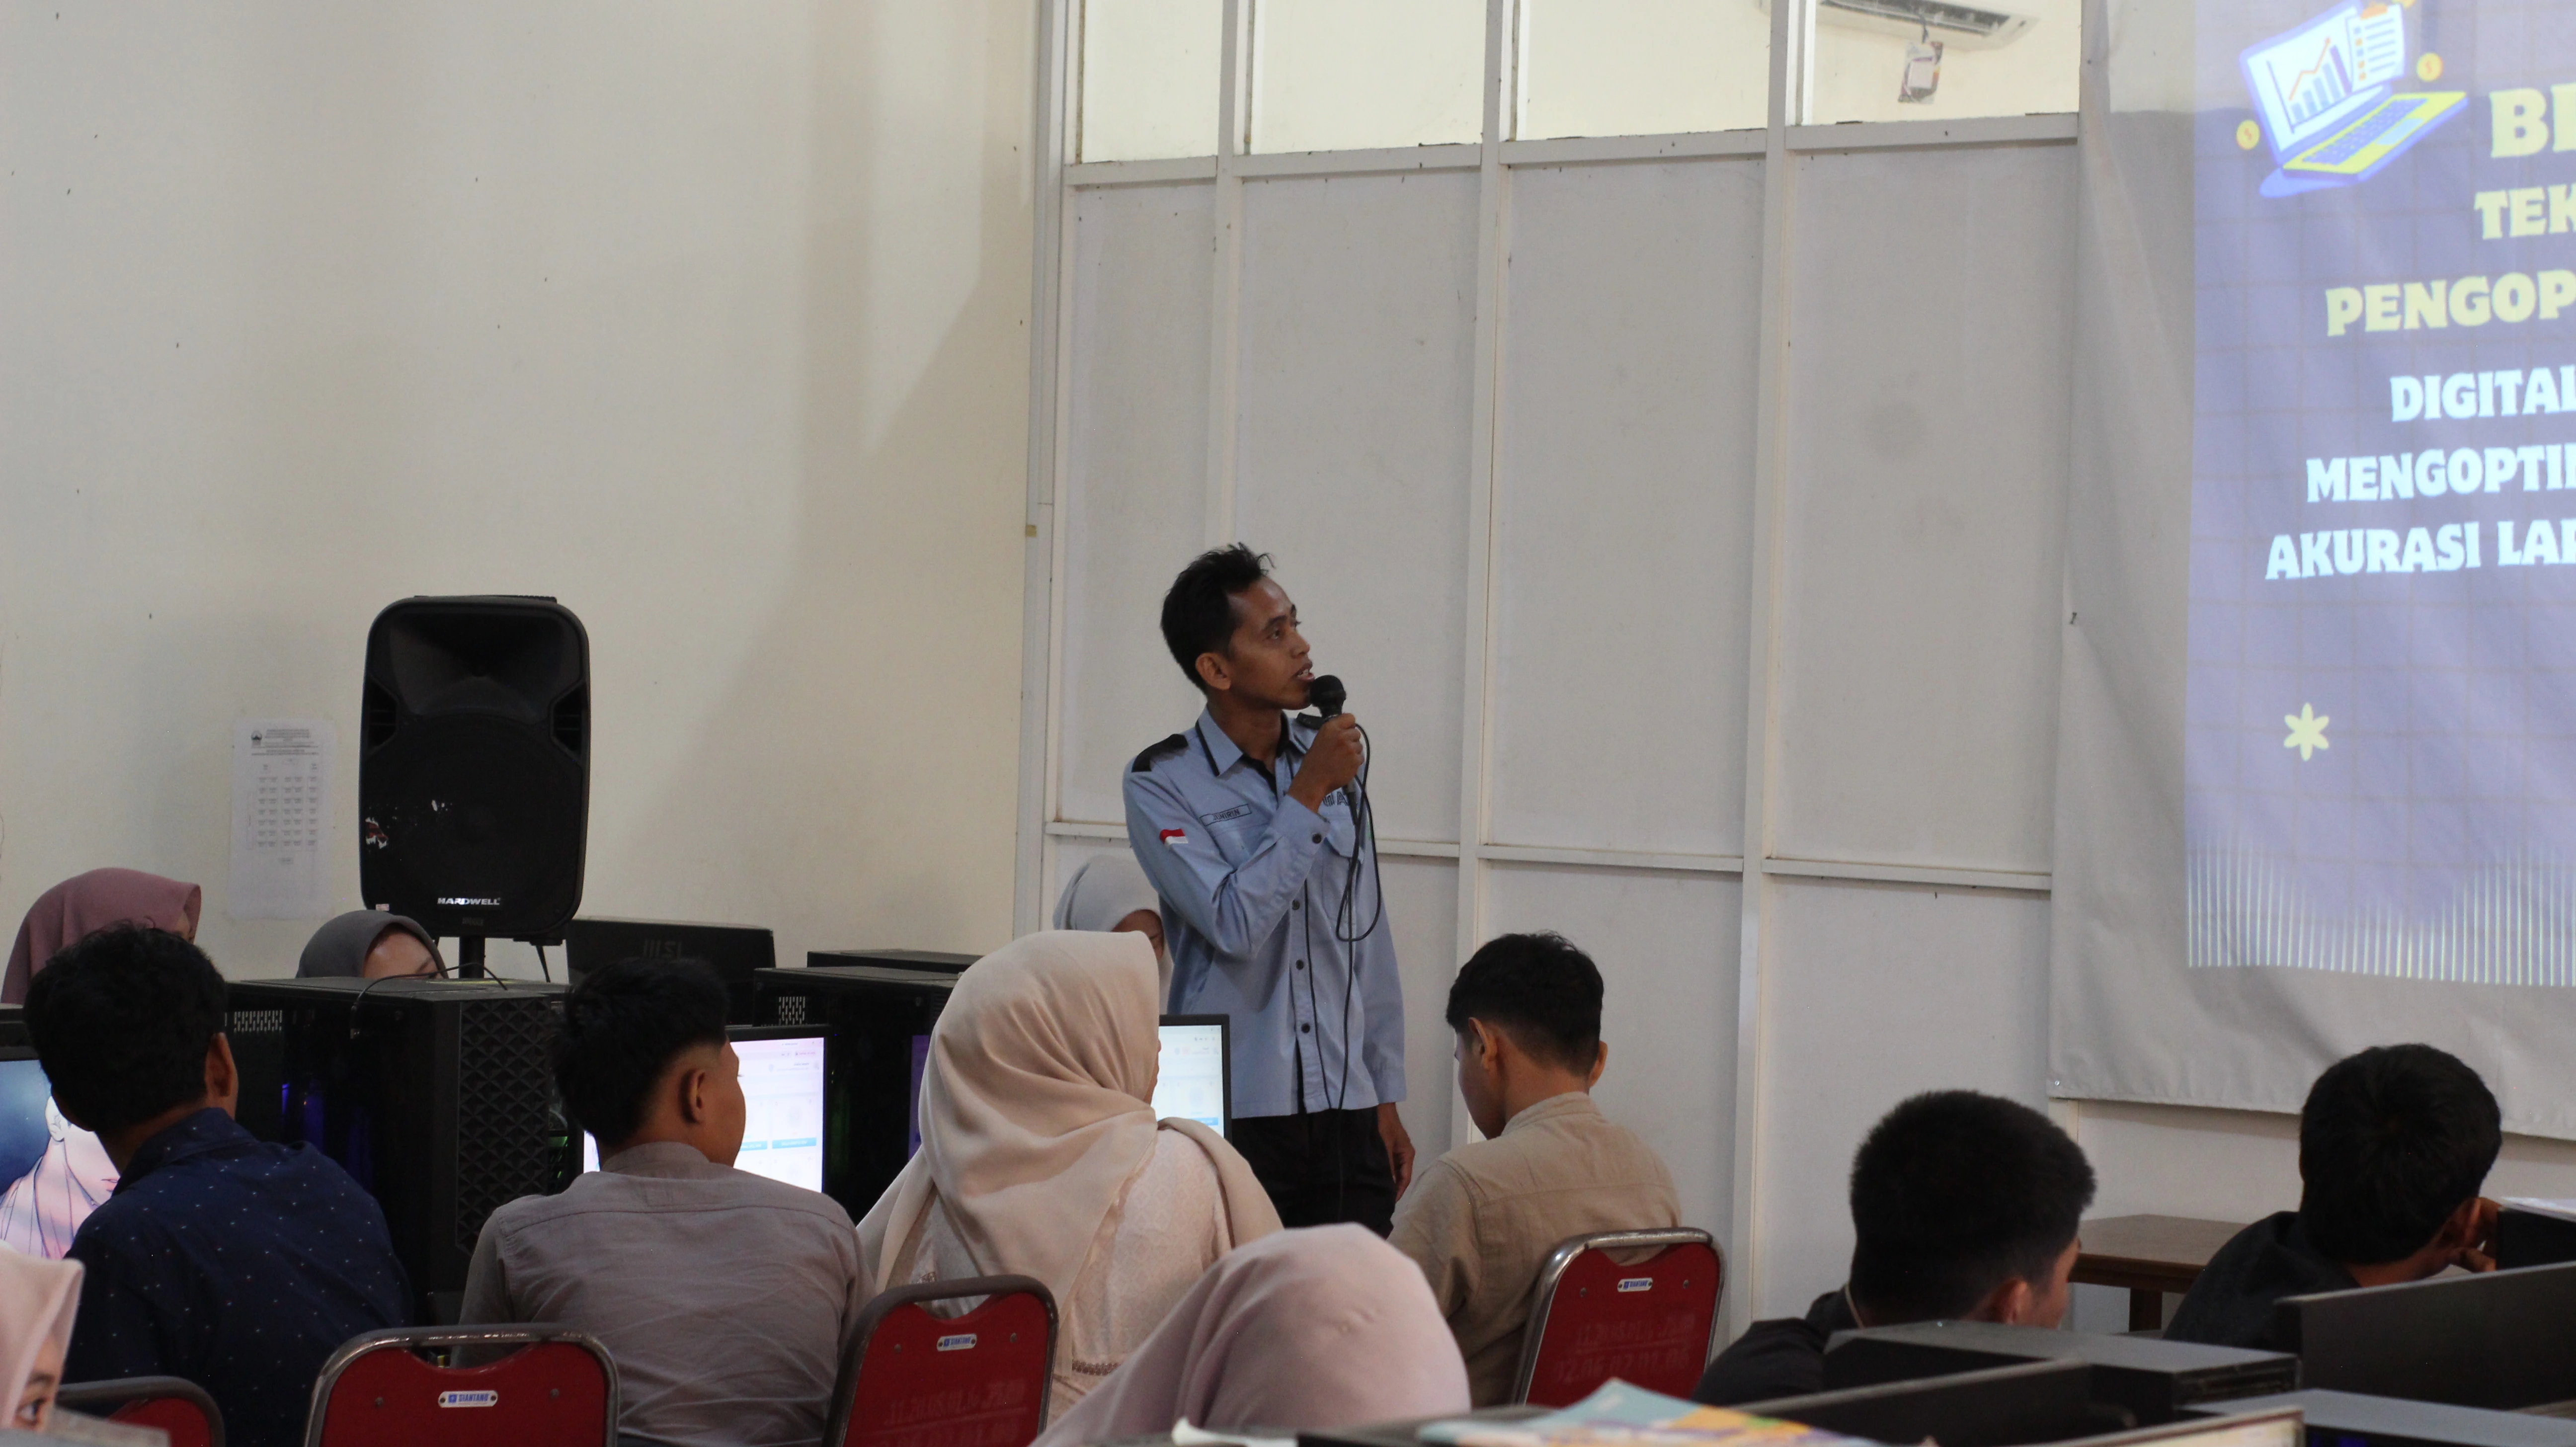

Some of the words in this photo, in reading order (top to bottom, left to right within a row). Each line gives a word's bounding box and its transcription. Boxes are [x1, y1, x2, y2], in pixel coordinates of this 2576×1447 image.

[2326, 270, 2576, 336] PENGOP
[2390, 365, 2576, 422] DIGITAL
[2265, 521, 2481, 579] AKURASI
